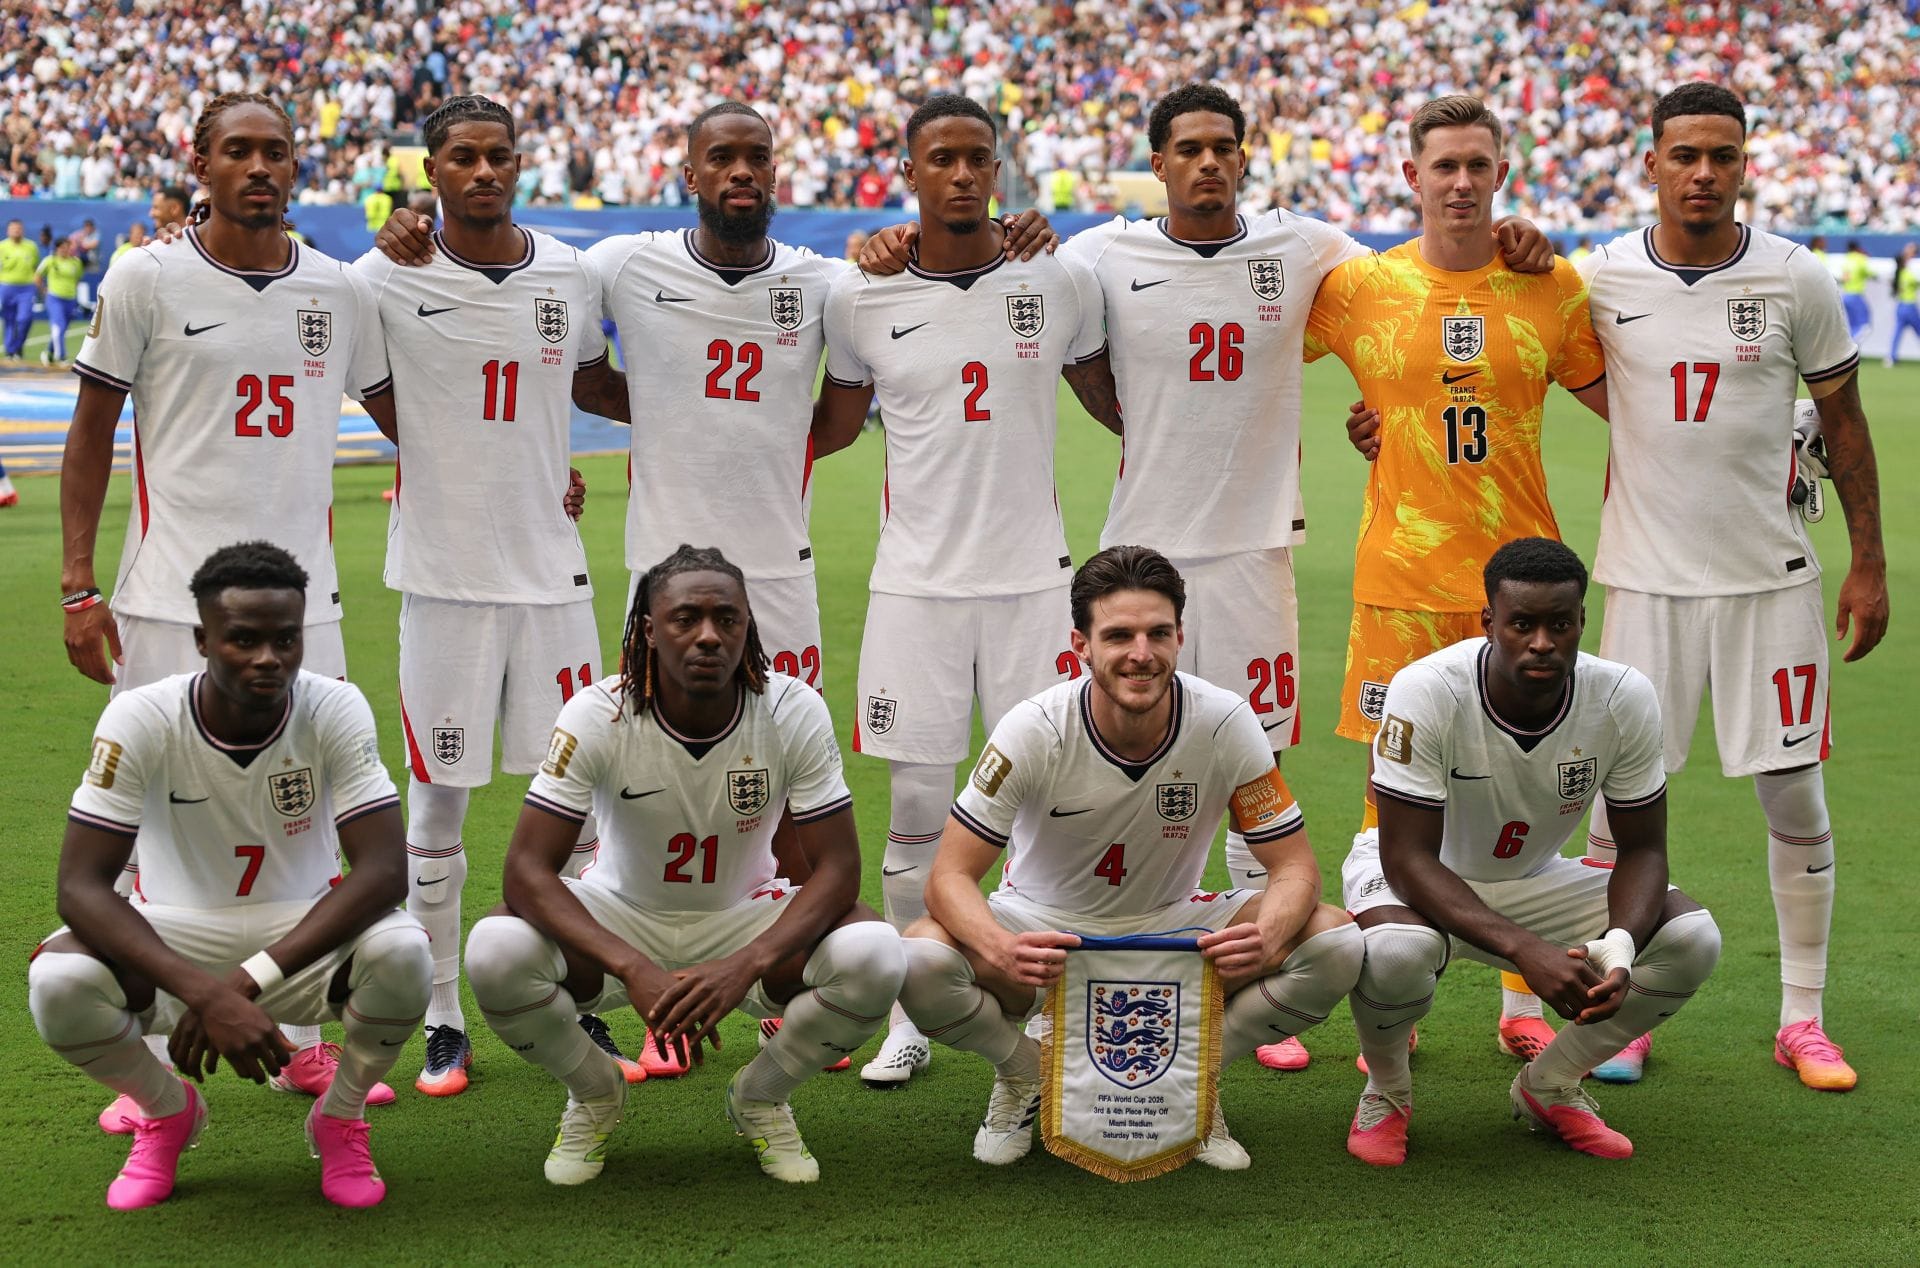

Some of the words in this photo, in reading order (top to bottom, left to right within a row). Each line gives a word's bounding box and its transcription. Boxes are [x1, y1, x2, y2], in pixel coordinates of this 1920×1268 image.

[1258, 305, 1282, 313] FRANCE
[541, 347, 563, 356] FRANCE
[1015, 342, 1040, 350] FRANCE
[1189, 322, 1244, 381] 26
[1735, 345, 1761, 353] FRANCE
[303, 360, 326, 368] FRANCE
[705, 338, 763, 402] 22
[482, 359, 519, 422] 11
[962, 361, 990, 422] 2
[1450, 386, 1476, 394] FRANCE
[1670, 361, 1720, 422] 17
[235, 374, 294, 437] 25
[1441, 405, 1488, 464] 13
[1809, 480, 1820, 515] reusch
[1247, 652, 1295, 715] 26
[1772, 663, 1817, 727] 17
[1237, 778, 1271, 797] FOOTBALL
[1239, 784, 1276, 808] UNITES
[1243, 807, 1256, 818] the
[1257, 793, 1282, 813] World
[1258, 811, 1275, 821] FIFA
[283, 816, 311, 830] FRANCE
[736, 816, 762, 828] FRANCE
[1161, 825, 1190, 833] FRANCE
[1493, 820, 1530, 859] 6
[663, 832, 719, 884] 21
[1094, 843, 1128, 887] 4
[235, 845, 265, 897] 7
[1098, 1094, 1111, 1102] FIFA
[1114, 1095, 1132, 1103] World
[1133, 1096, 1146, 1104] Cup
[1148, 1096, 1164, 1104] 2026
[1125, 1107, 1142, 1115] Place
[1144, 1107, 1157, 1115] Play
[1159, 1107, 1169, 1115] Off
[1102, 1131, 1130, 1140] Saturday
[1146, 1132, 1159, 1140] July
